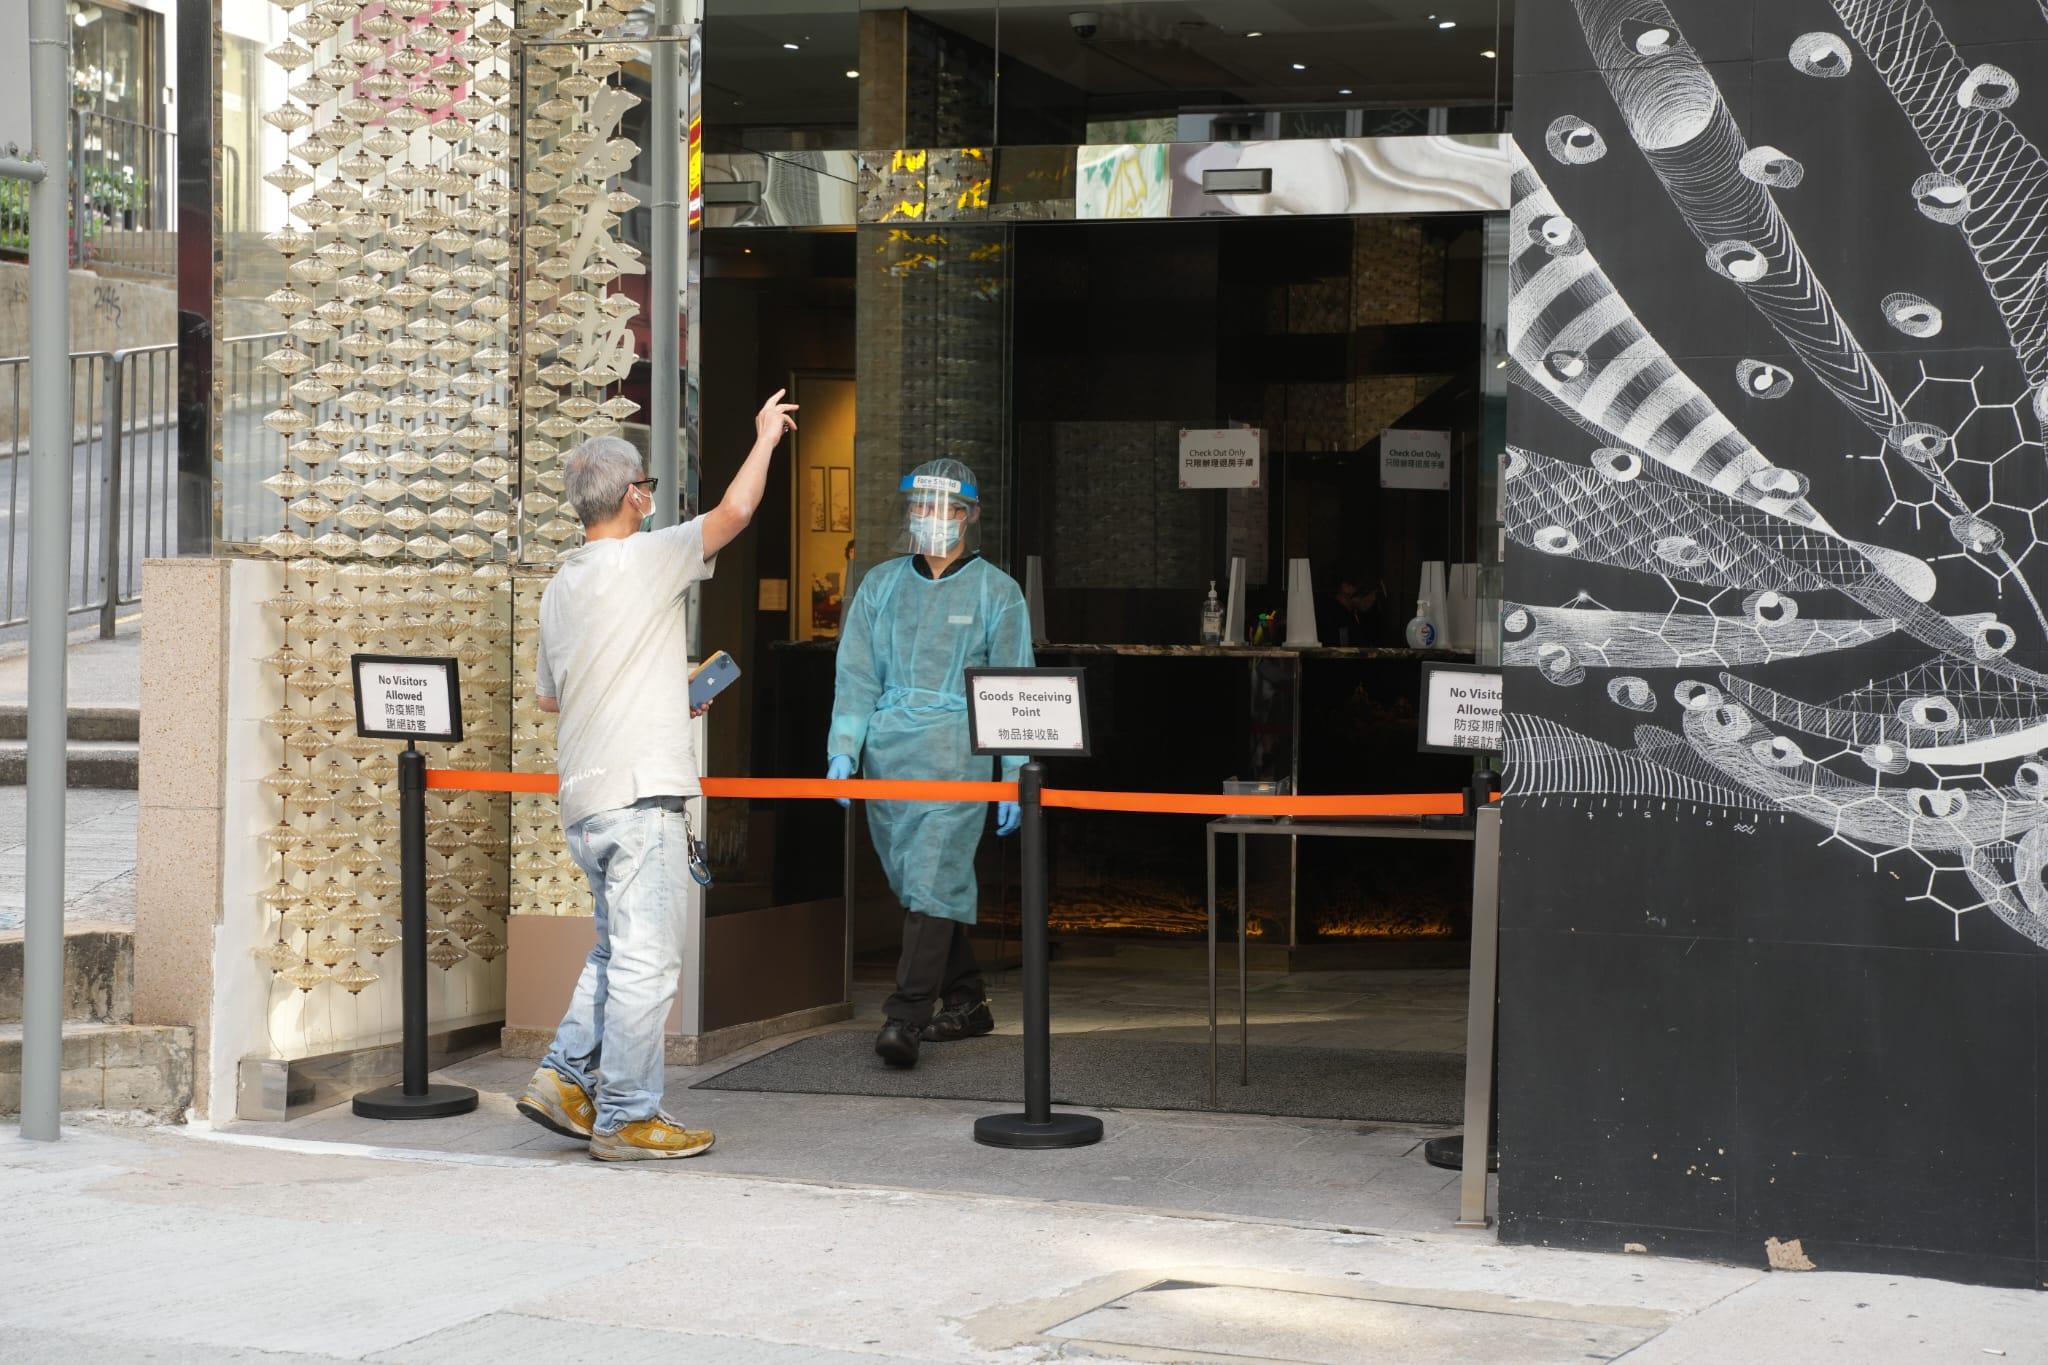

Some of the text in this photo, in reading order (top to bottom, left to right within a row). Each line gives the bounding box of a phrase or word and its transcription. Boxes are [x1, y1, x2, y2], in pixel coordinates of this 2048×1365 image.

[1189, 448, 1246, 458] Check Out Only
[1389, 448, 1442, 460] Check Out Only
[378, 674, 428, 687] No Visitors
[385, 690, 423, 701] Allowed
[979, 691, 1072, 704] Goods Receiving
[1449, 687, 1467, 698] No
[385, 703, 426, 717] 防疫期間
[1011, 706, 1041, 717] Point
[386, 718, 427, 731] 謝絕訪客
[997, 728, 1060, 741] 物品接收點
